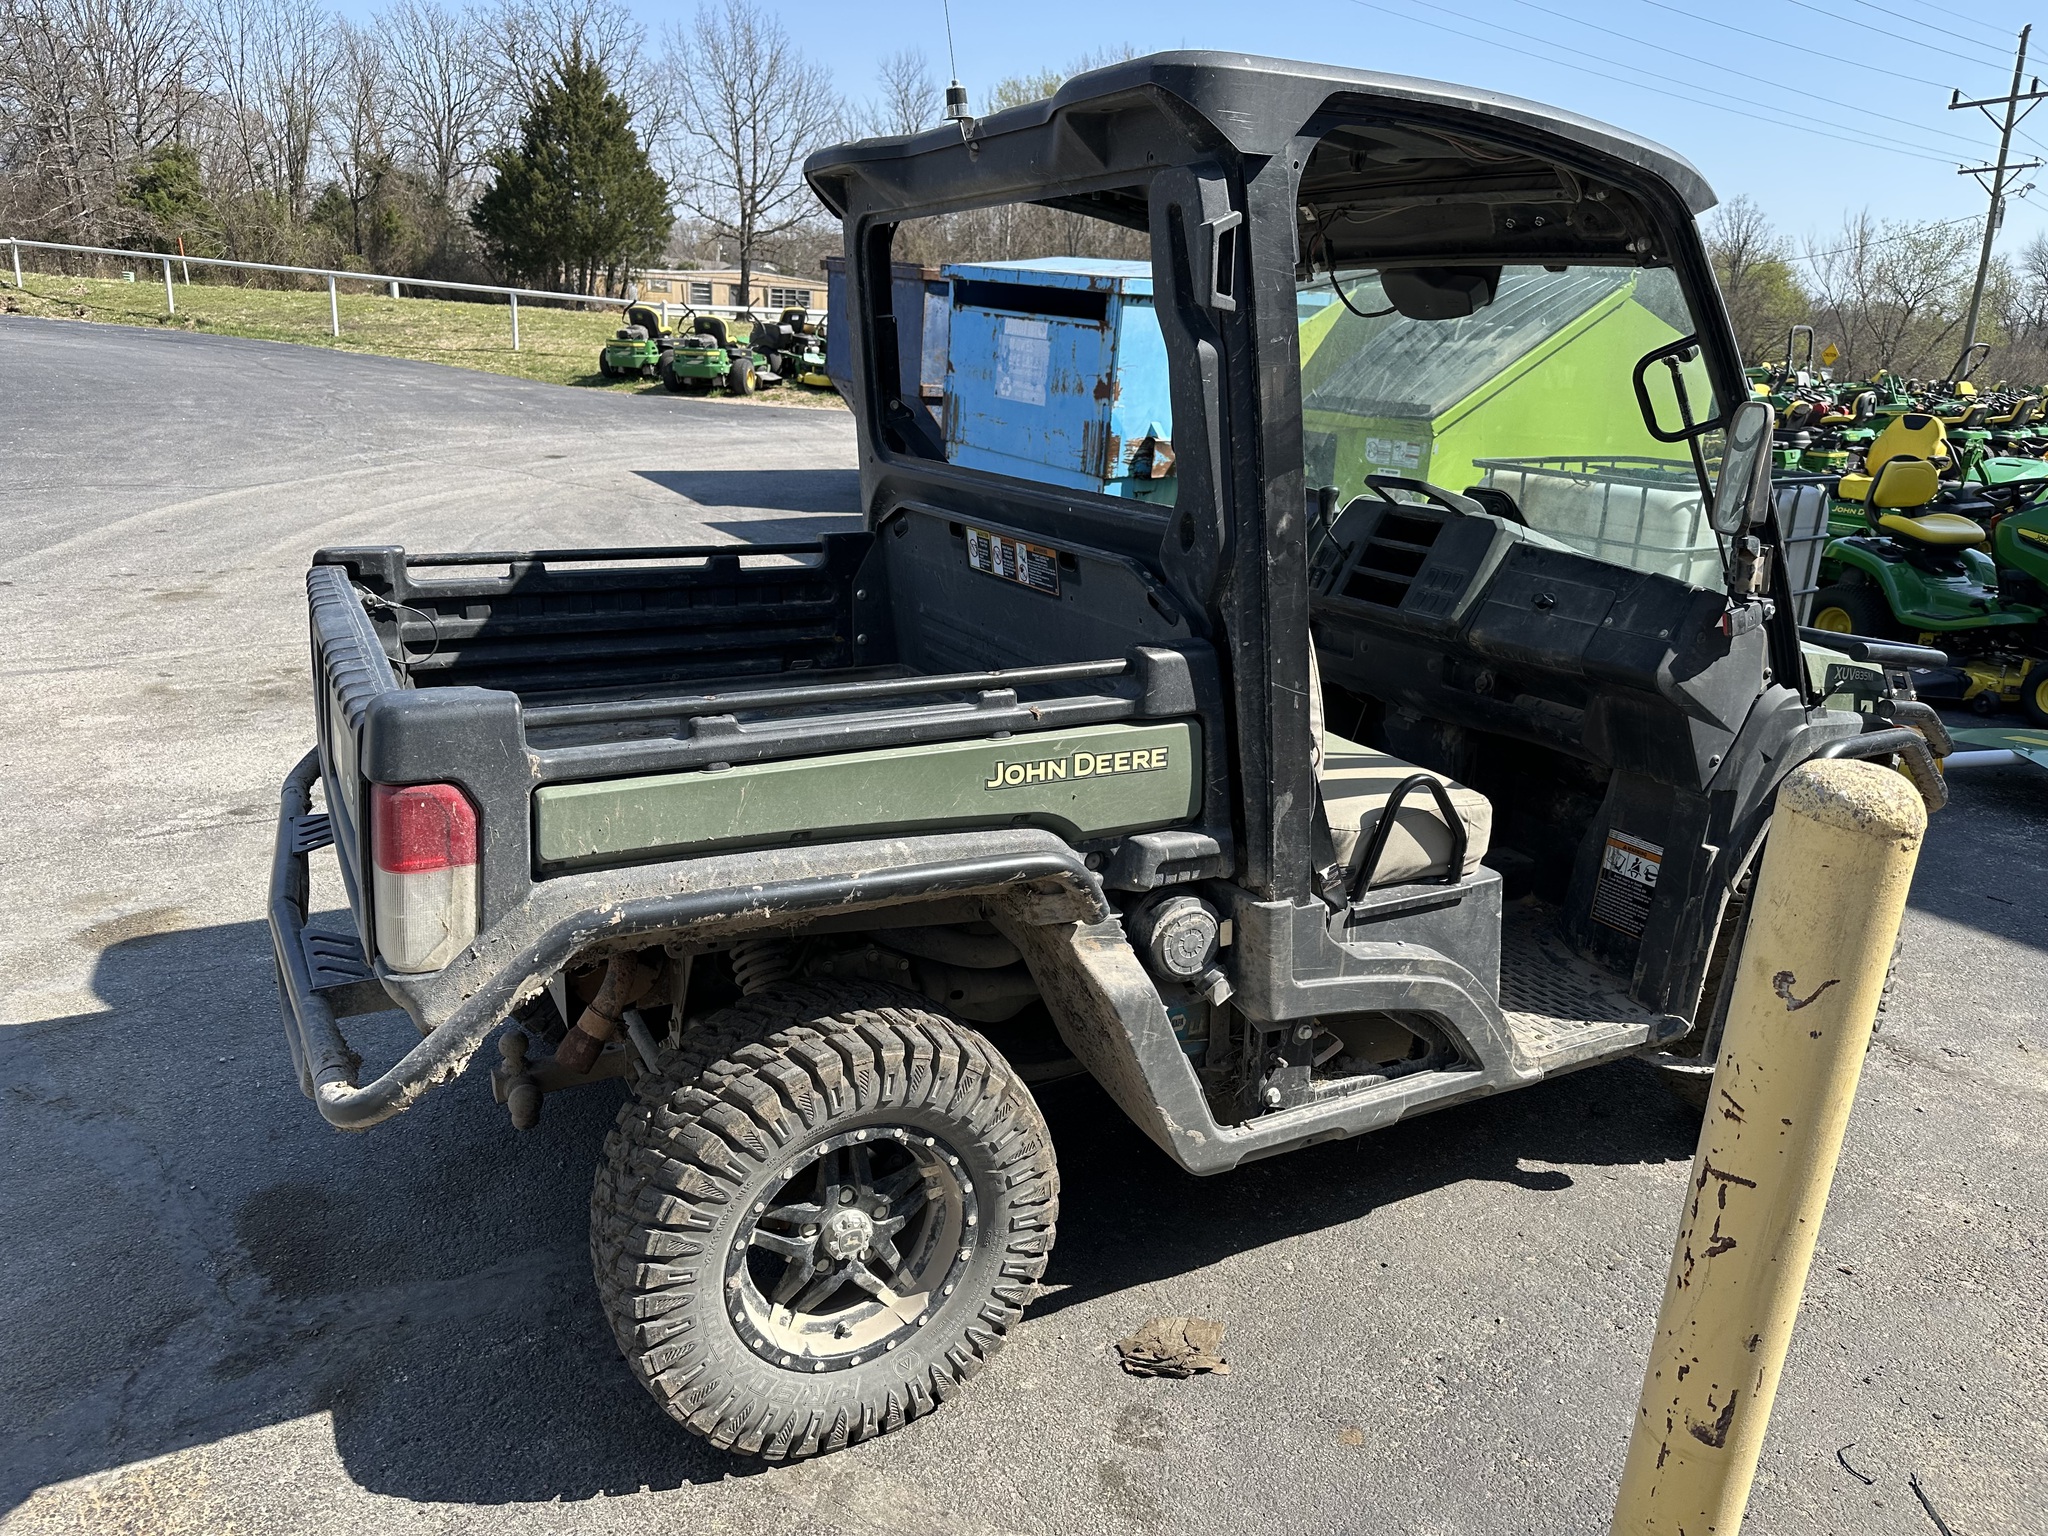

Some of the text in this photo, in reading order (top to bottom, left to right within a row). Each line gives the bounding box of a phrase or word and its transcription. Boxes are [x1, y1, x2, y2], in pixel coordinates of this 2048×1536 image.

[1831, 505, 1857, 515] JOHN
[986, 747, 1169, 789] JOHN DEERE
[735, 1180, 754, 1201] NHS
